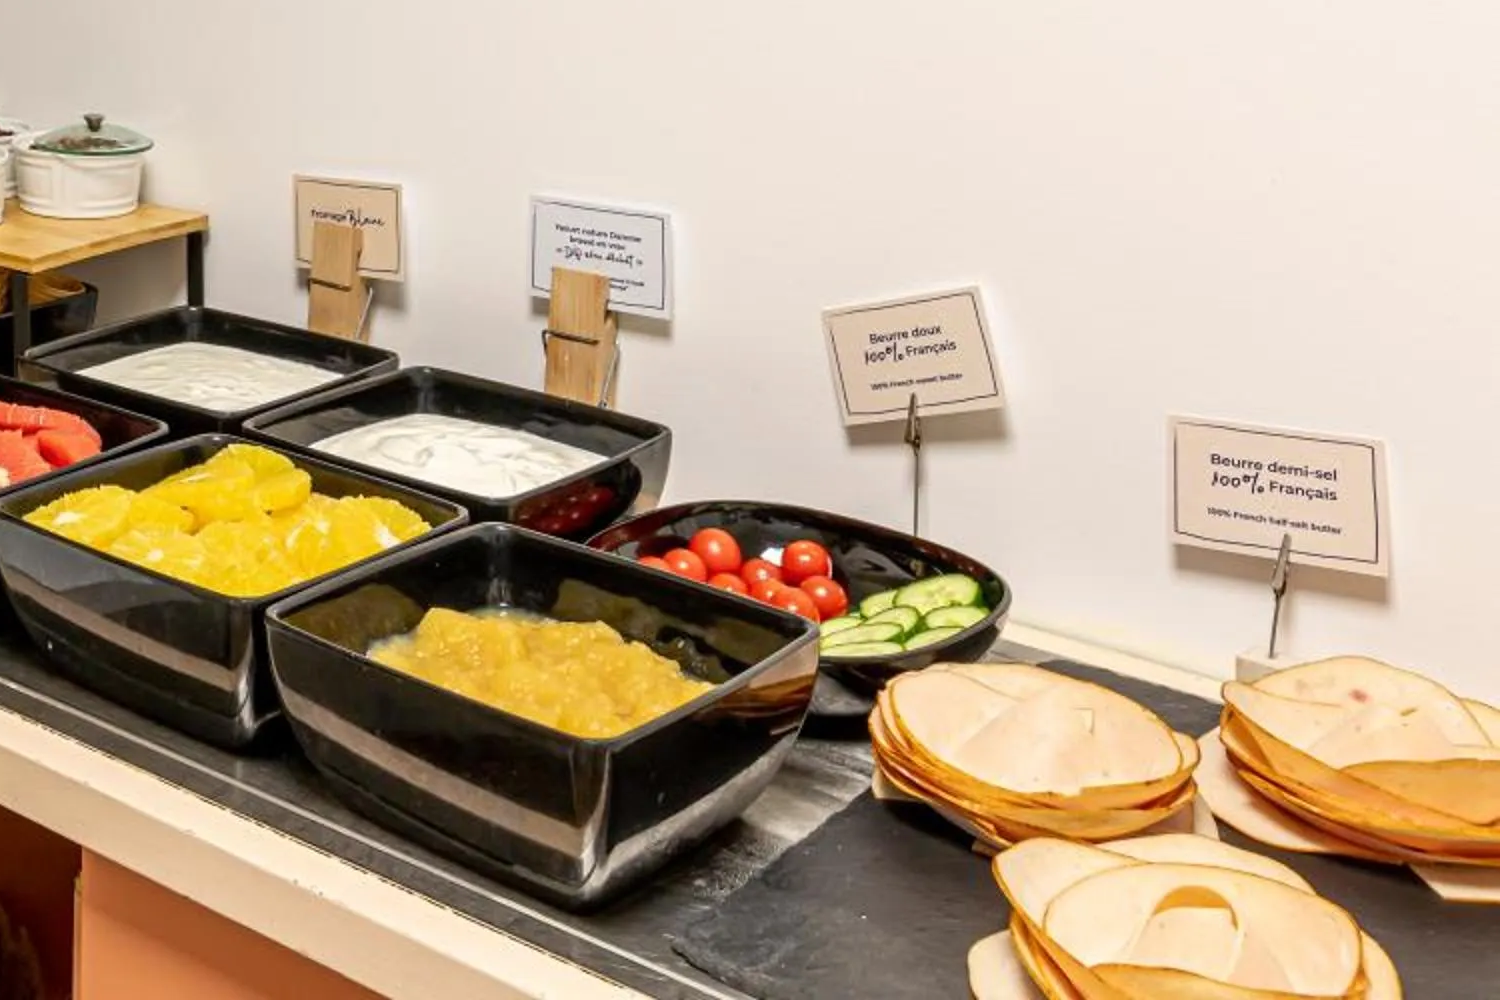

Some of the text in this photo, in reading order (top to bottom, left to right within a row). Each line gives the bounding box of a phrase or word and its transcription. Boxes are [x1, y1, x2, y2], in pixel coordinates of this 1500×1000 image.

[869, 325, 942, 344] Beurre doux
[864, 339, 957, 365] 100% Français
[1210, 452, 1338, 482] Beurre demi-sel
[1211, 471, 1338, 501] 100% Français
[1233, 511, 1267, 524] French
